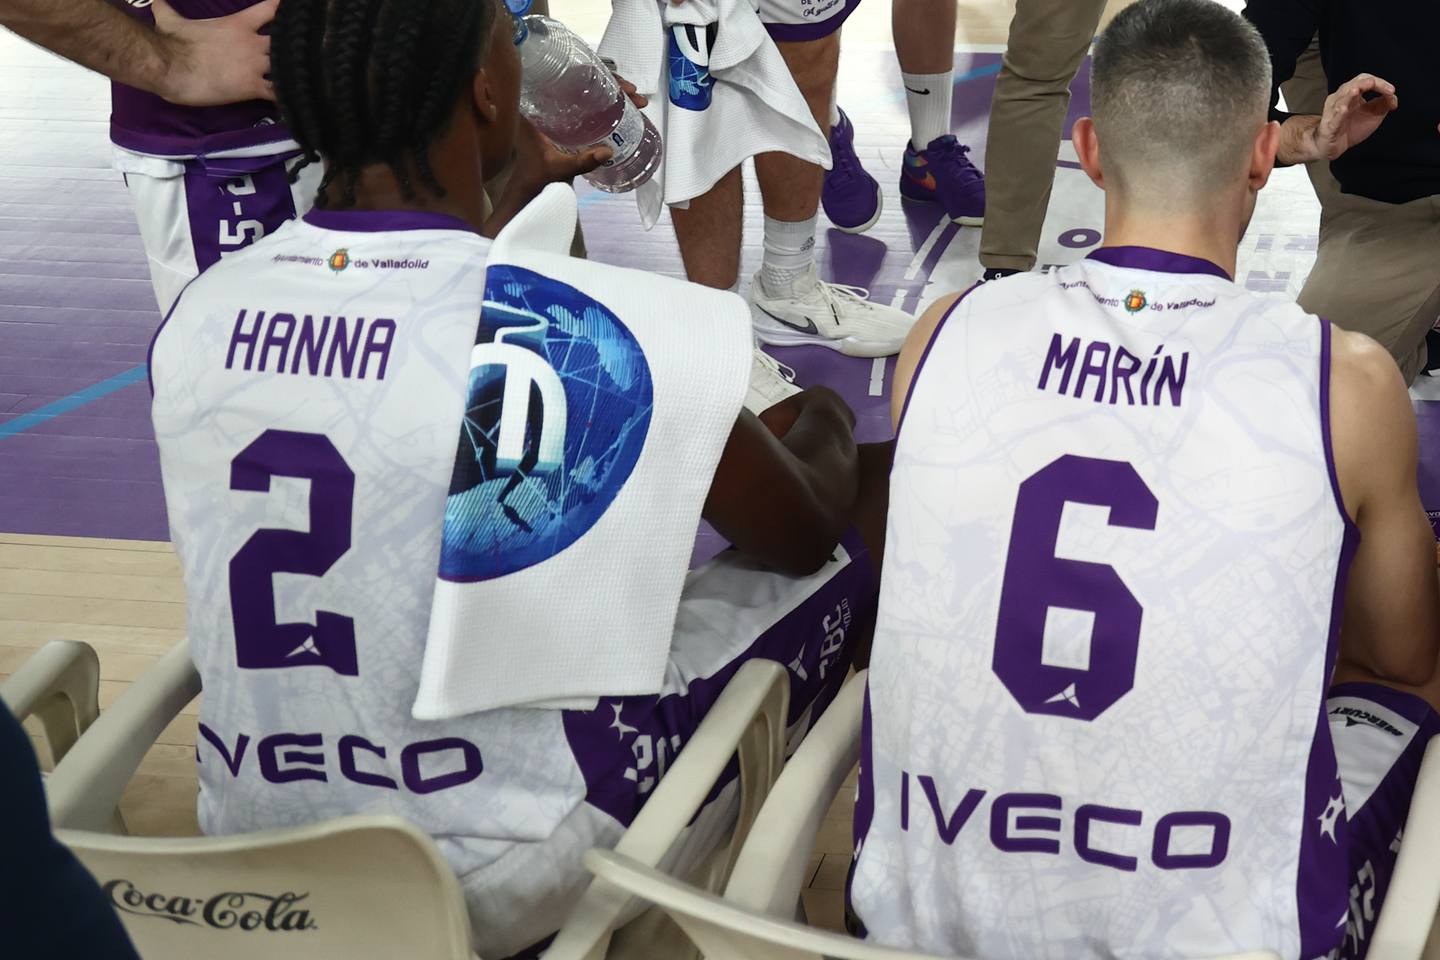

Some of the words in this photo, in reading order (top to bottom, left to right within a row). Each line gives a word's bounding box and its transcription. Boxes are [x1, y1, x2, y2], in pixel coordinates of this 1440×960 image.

[354, 258, 369, 269] de
[371, 258, 430, 270] Valladolid
[1150, 300, 1164, 312] de
[225, 309, 397, 381] HANNA
[1037, 332, 1190, 407] MARÍN
[229, 428, 359, 677] 2
[991, 453, 1159, 722] 6
[197, 721, 485, 795] VECO
[900, 771, 1232, 872] IVECO
[101, 878, 316, 932] Coca-Cola
